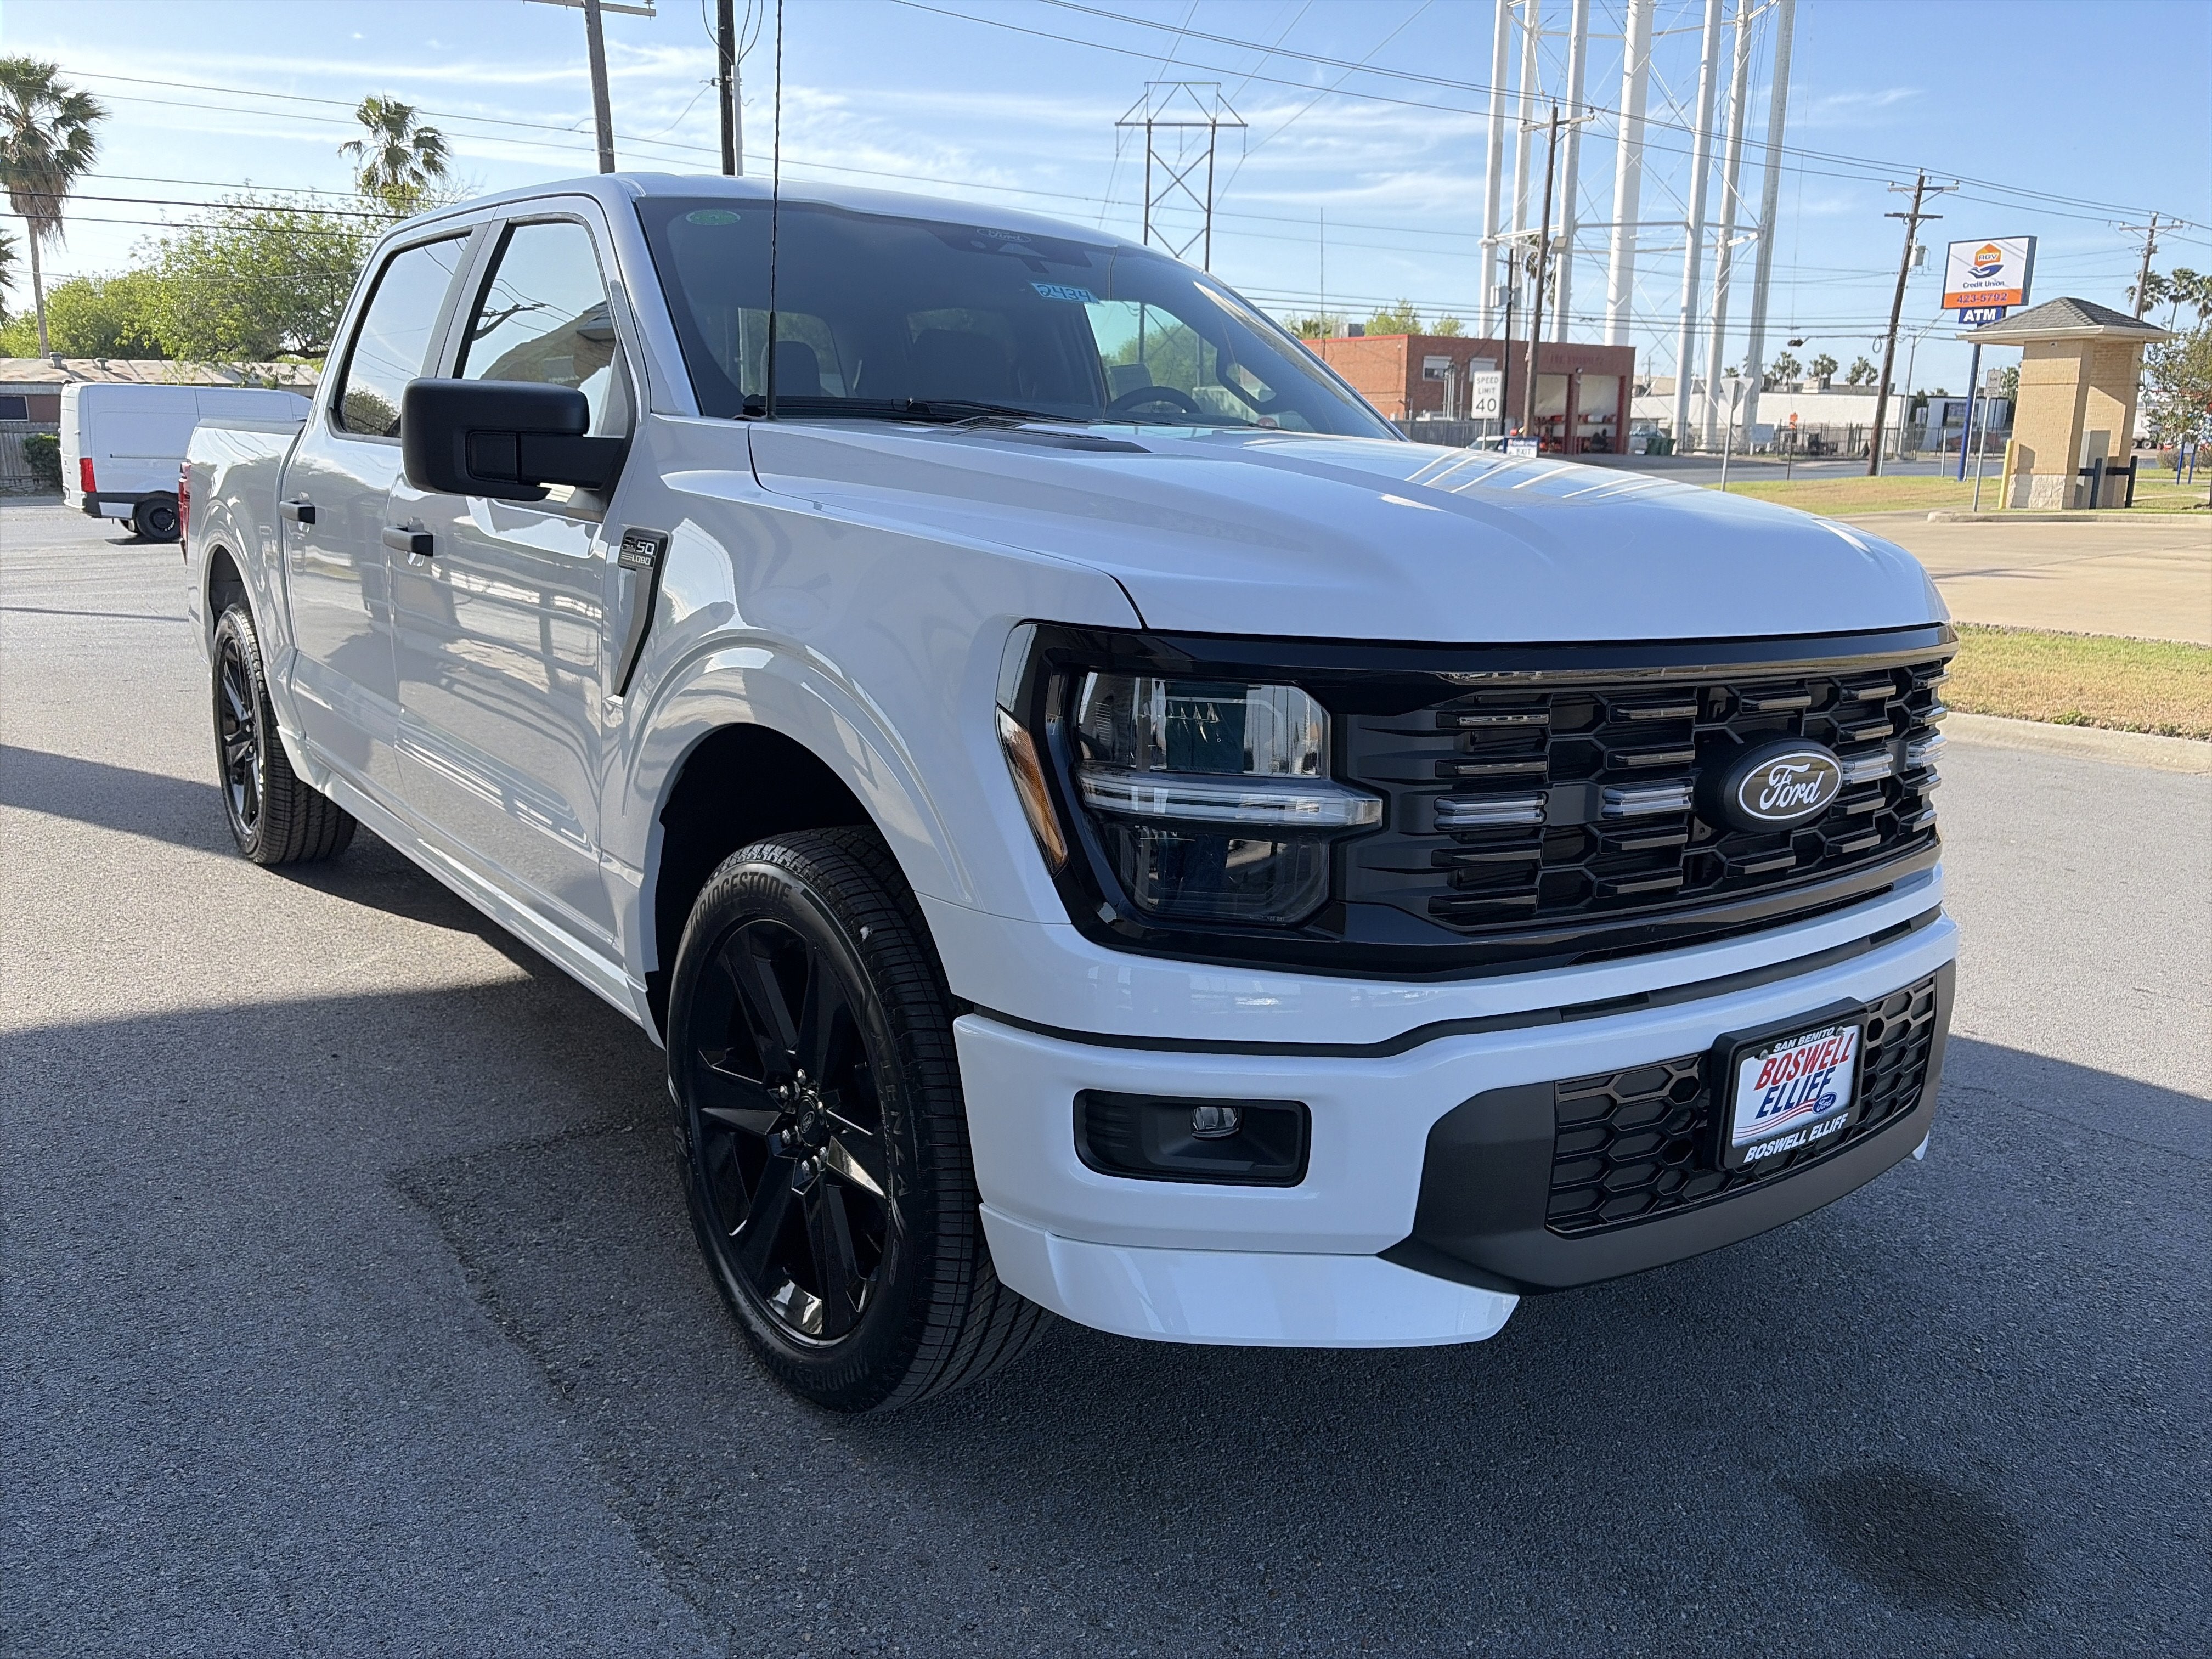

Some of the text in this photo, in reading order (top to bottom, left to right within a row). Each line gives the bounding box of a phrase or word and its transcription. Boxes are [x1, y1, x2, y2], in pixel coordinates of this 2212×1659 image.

[988, 229, 1023, 241] Ford
[1036, 285, 1091, 301] 2434
[1956, 293, 2007, 303] 423-5792
[1963, 308, 1996, 322] ATM
[1476, 398, 1497, 412] 40
[632, 554, 651, 565] LOBO
[1759, 763, 1824, 810] Ford
[1773, 1026, 1835, 1053] SAN BENITO
[1753, 1032, 1855, 1091] BOSWELL
[1755, 1066, 1837, 1120] ELLIFF
[1816, 1097, 1832, 1111] Ford
[1743, 1130, 1807, 1163] BOSWELL
[1808, 1113, 1849, 1142] ELLIFF
